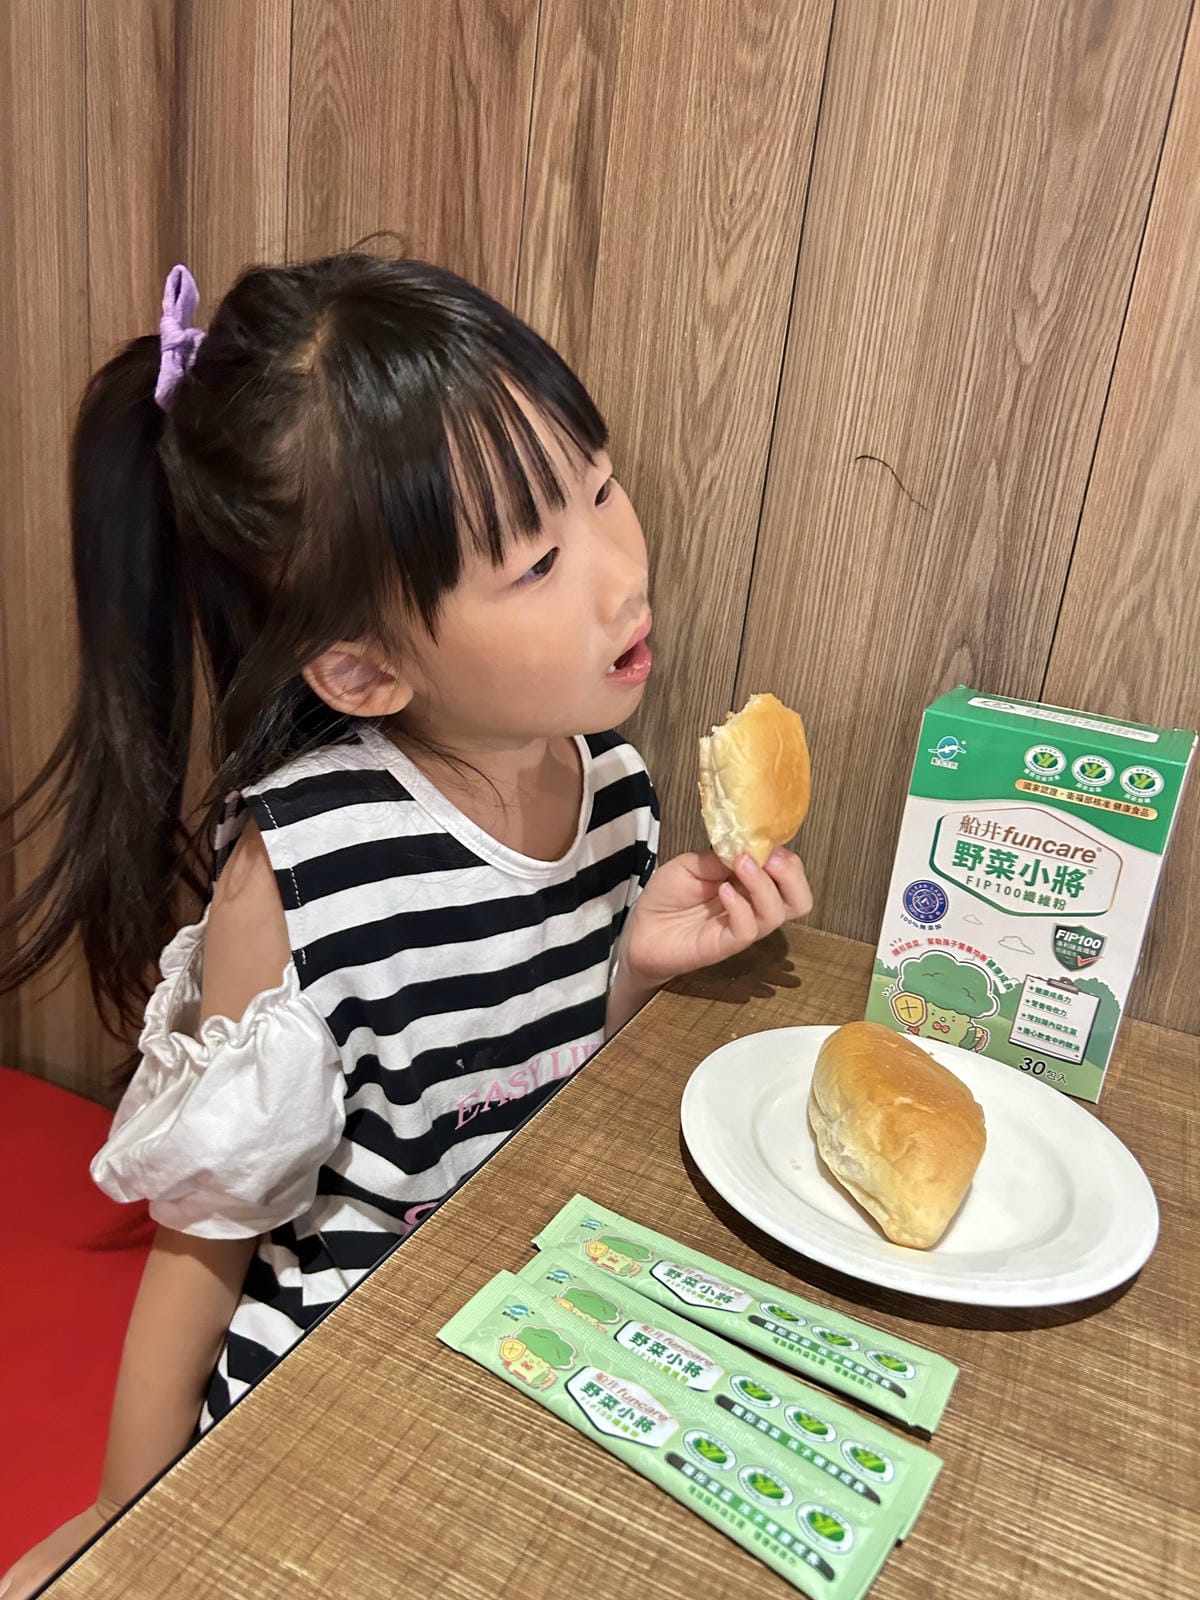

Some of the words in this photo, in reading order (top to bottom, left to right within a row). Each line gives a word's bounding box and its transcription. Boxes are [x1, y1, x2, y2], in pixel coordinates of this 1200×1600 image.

[951, 839, 1088, 899] 野菜小將
[966, 875, 1067, 911] FIP100纖維粉
[1055, 928, 1102, 950] FIP100
[455, 1057, 541, 1130] EASY
[663, 1267, 734, 1304] 野菜小將
[628, 1331, 704, 1379] 野菜小將
[579, 1380, 657, 1434] 野菜小將
